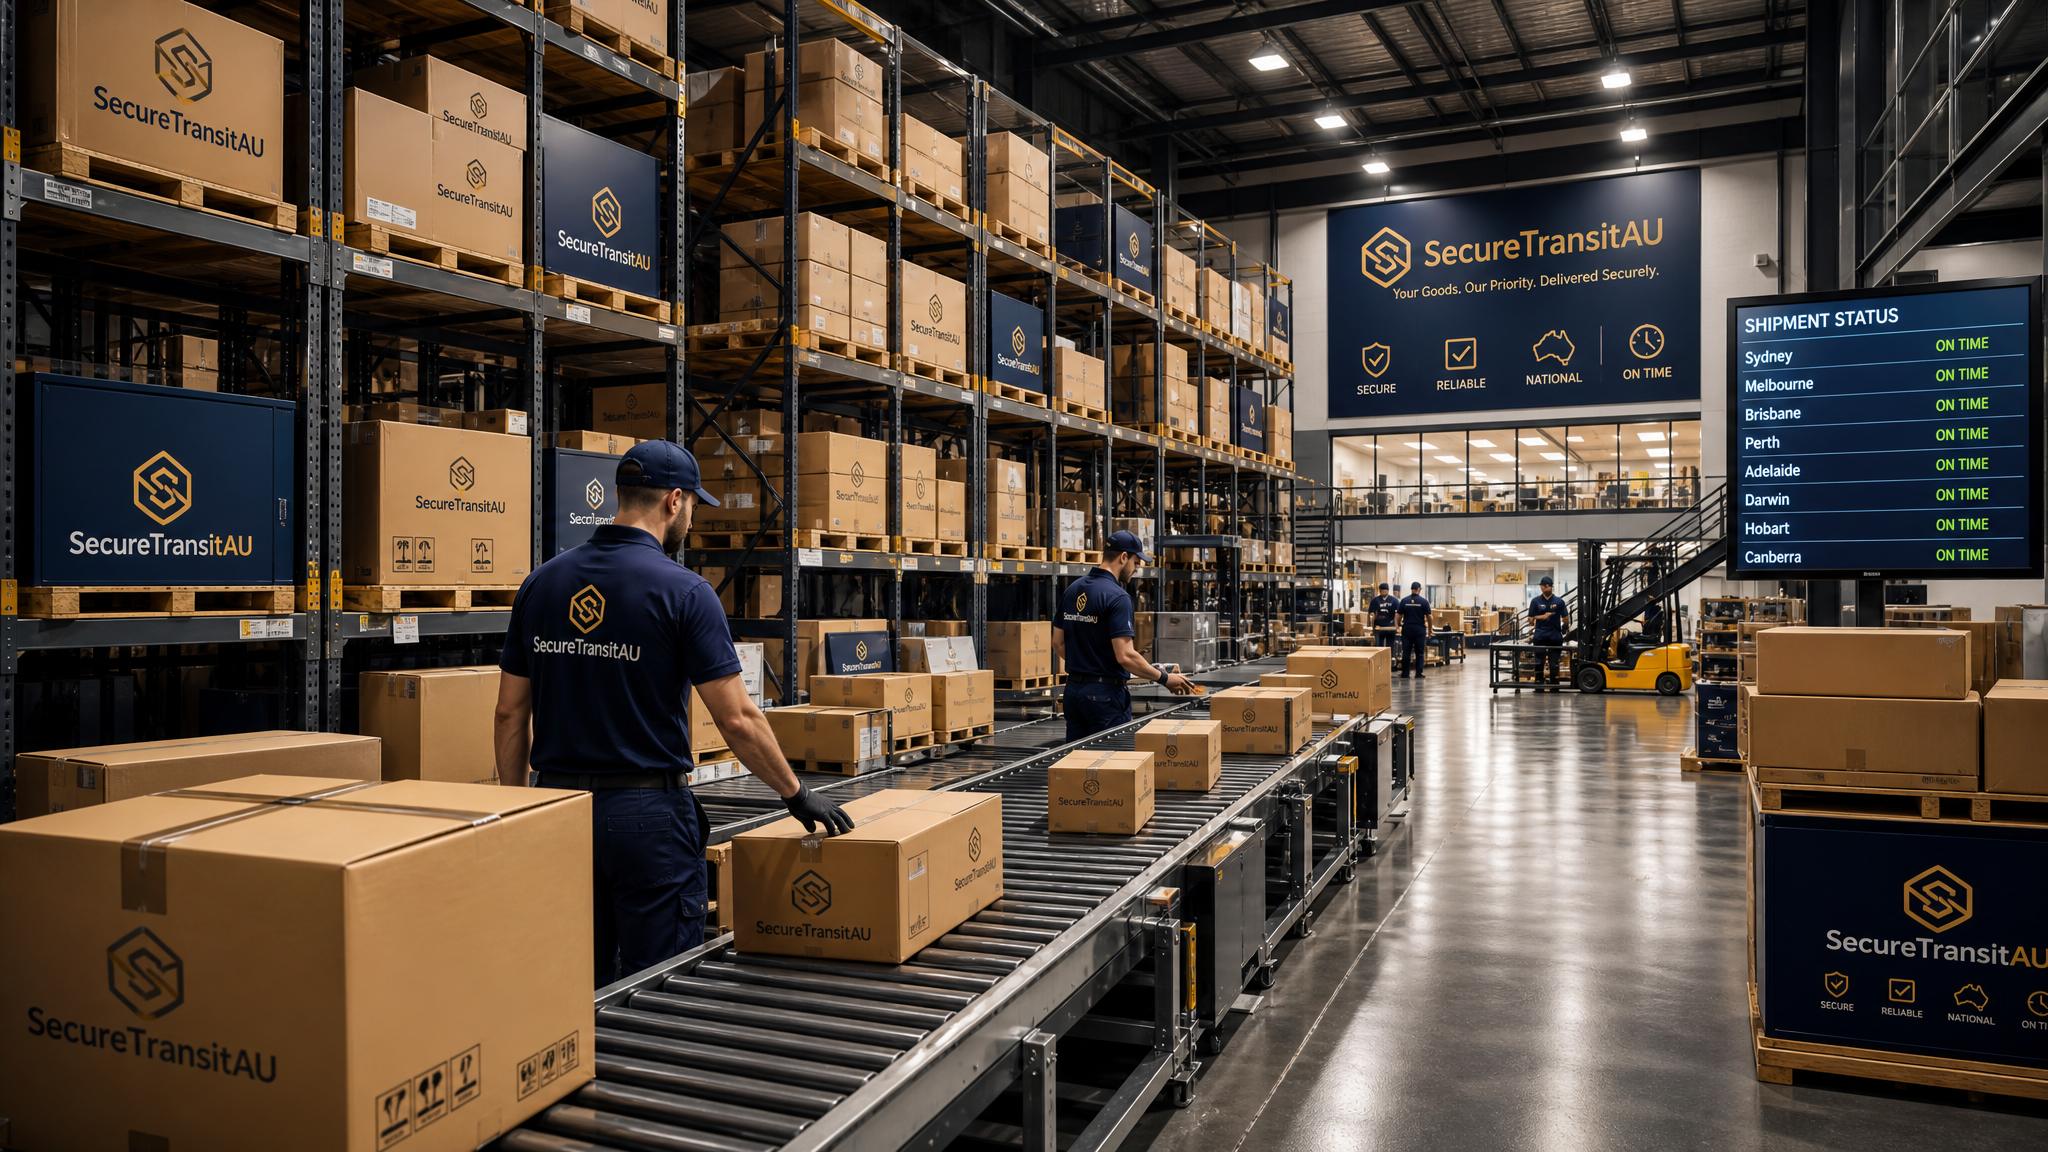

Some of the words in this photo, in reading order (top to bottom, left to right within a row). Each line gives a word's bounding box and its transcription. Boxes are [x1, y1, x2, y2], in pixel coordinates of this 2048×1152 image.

[94, 85, 263, 158] SecureTransitAU
[437, 183, 513, 217] SecureTransitAU
[558, 228, 650, 271] SecureTransitAU
[1425, 218, 1663, 267] SecureTransitAU
[1394, 287, 1419, 299] Your
[1422, 284, 1461, 297] Goods.
[1465, 282, 1487, 293] Our
[1491, 277, 1536, 290] Priority.
[1541, 270, 1598, 286] Delivered
[1603, 265, 1659, 280] Securely.
[1745, 313, 1830, 333] SHIPMENT
[1835, 308, 1898, 326] STATUS
[1746, 350, 1792, 367] Sydney
[1936, 339, 1954, 351] ON
[1958, 337, 1988, 350] TIME
[1527, 373, 1582, 385] NATIONAL
[1623, 369, 1640, 379] ON
[1643, 367, 1671, 378] TIME
[1746, 379, 1813, 392] Melbourne
[1936, 369, 1954, 381] ON
[1958, 367, 1988, 380] TIME
[1357, 384, 1396, 395] SECURE
[1437, 378, 1485, 390] RELIABLE
[1746, 407, 1801, 421] Brisbane
[1936, 399, 1954, 411] ON
[1958, 397, 1988, 410] TIME
[1746, 436, 1779, 449] Perth
[1936, 429, 1954, 441] ON
[1958, 427, 1988, 440] TIME
[1745, 464, 1800, 477] Adelaide
[1936, 459, 1954, 471] ON
[1958, 458, 1988, 470] TIME
[416, 495, 505, 513] SecureTransitAU
[1746, 493, 1789, 506] Darwin
[1936, 489, 1954, 501] ON
[1958, 488, 1988, 500] TIME
[1746, 522, 1789, 535] Hobart
[1936, 519, 1954, 531] ON
[1958, 518, 1988, 530] TIME
[70, 531, 252, 556] SecureTransitAU
[1745, 551, 1801, 563] Canberra
[1936, 549, 1954, 561] ON
[1958, 549, 1988, 560] TIME
[534, 636, 640, 661] SecureTransitAU
[1058, 796, 1124, 806] SecureTransitAU
[756, 920, 870, 941] SecureTransitAU
[1826, 930, 2048, 968] SecureTransitAU
[1821, 1001, 1854, 1011] SECURE
[1882, 1007, 1923, 1018] RELIABLE
[1948, 1014, 1995, 1025] NATIONAL
[2022, 1020, 2036, 1029] ON
[2038, 1022, 2048, 1030] TI
[28, 1006, 276, 1083] SecureTransitAU
